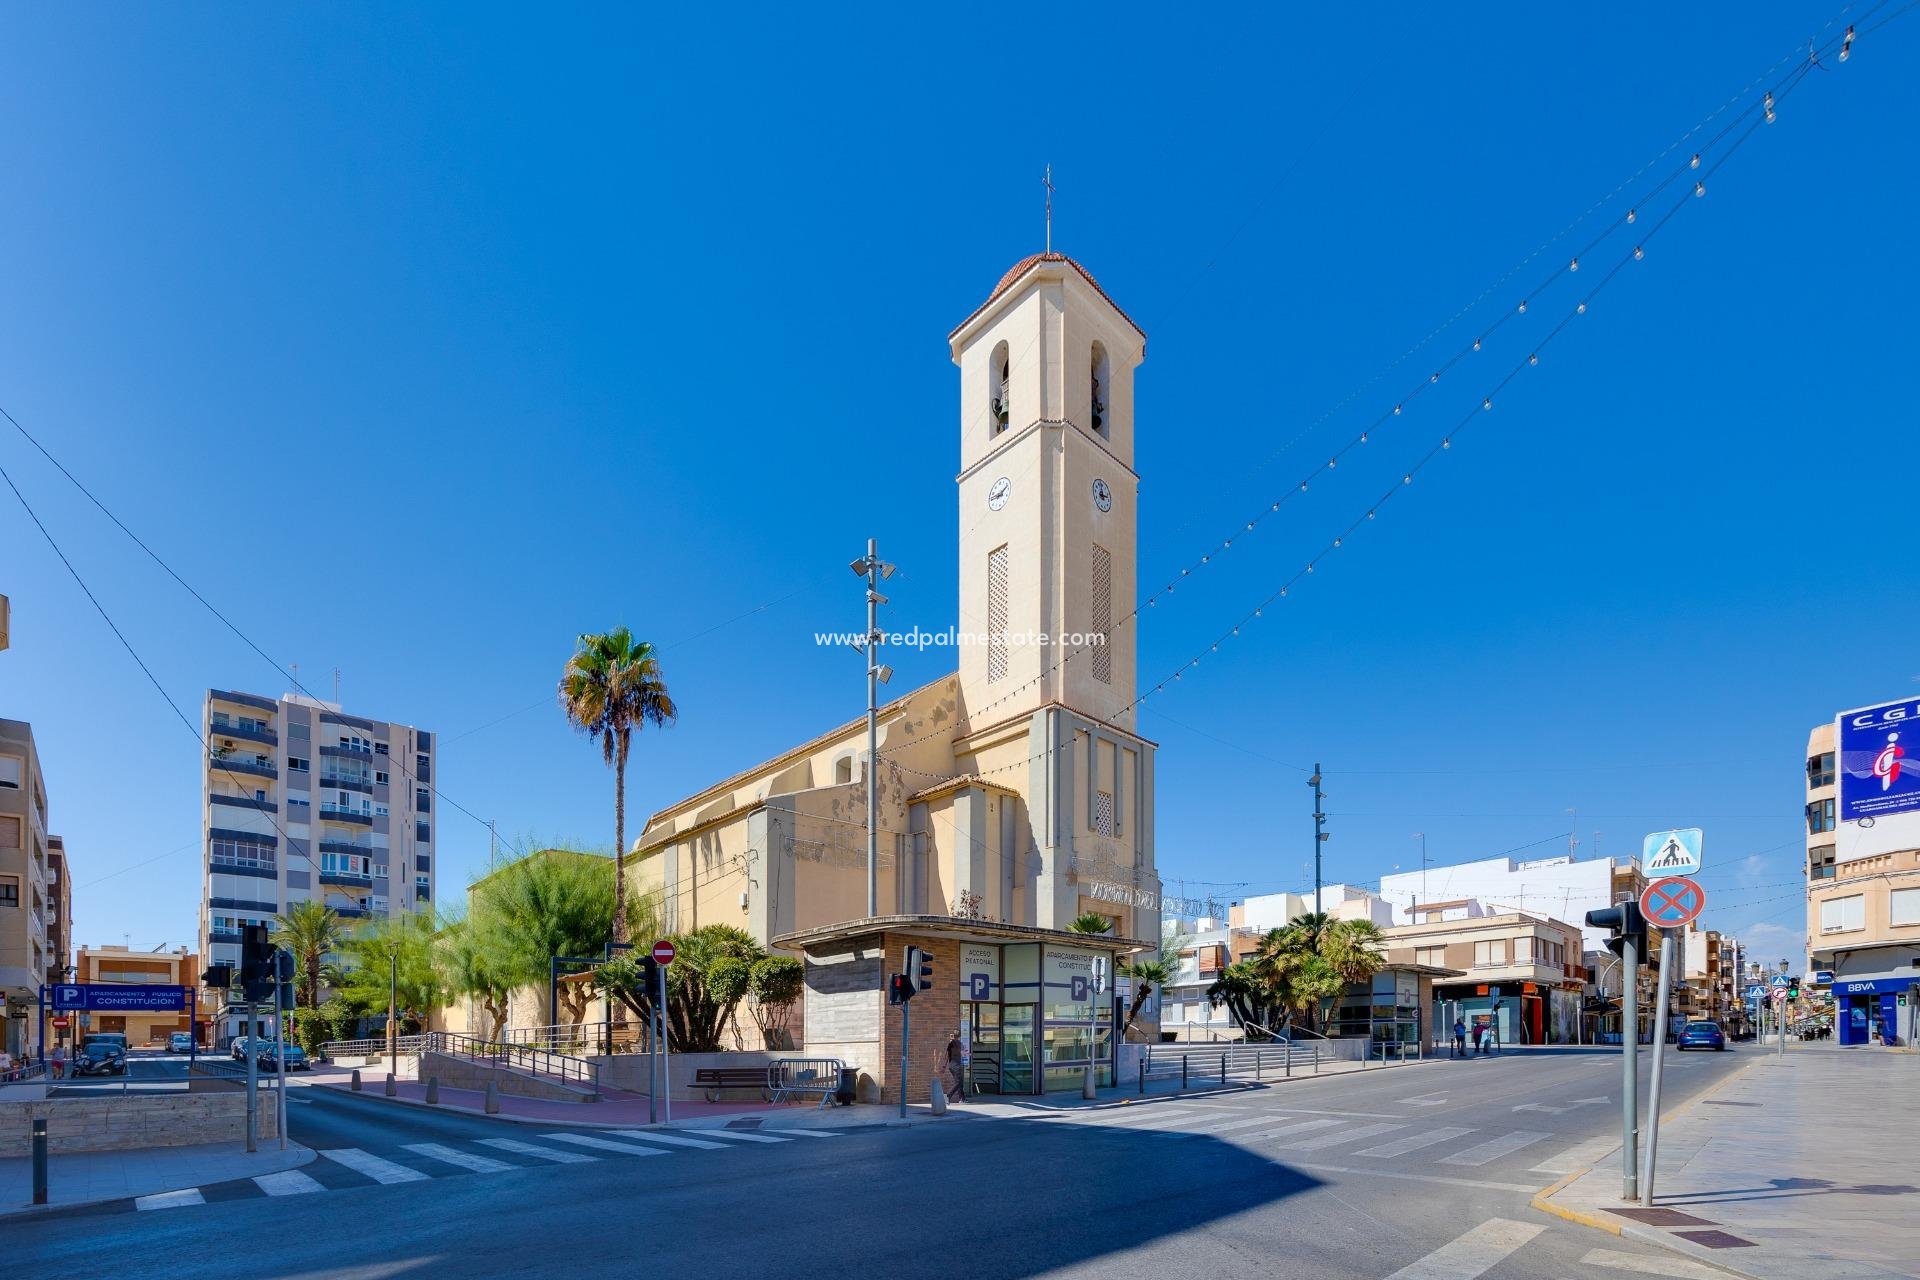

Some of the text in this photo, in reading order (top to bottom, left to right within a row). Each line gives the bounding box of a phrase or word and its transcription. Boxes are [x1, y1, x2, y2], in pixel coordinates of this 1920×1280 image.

[969, 949, 992, 958] ACCESO
[965, 957, 996, 966] PEATONAL
[1058, 961, 1092, 971] CONSTITUC
[974, 978, 986, 996] P
[1074, 980, 1084, 997] P
[1847, 982, 1875, 992] BBVA
[63, 988, 79, 1002] P
